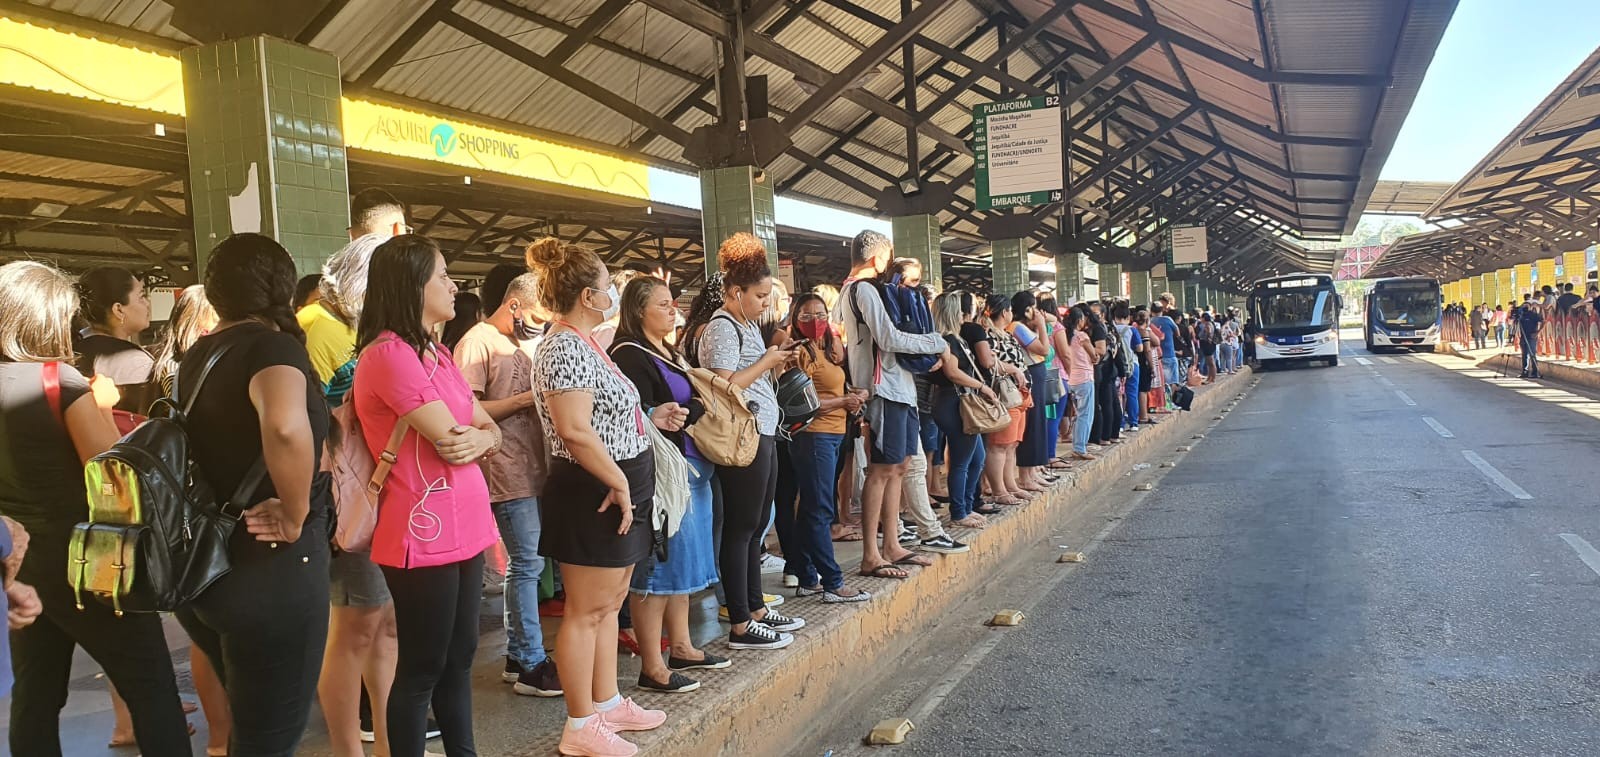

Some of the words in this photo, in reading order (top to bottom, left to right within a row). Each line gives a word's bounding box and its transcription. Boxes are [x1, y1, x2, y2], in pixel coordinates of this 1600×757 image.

[983, 100, 1033, 113] PLATAFORMA
[1046, 96, 1059, 106] B2
[376, 115, 428, 144] AQUIRI
[458, 132, 520, 160] SHOPPING
[991, 195, 1032, 206] EMBARQUE
